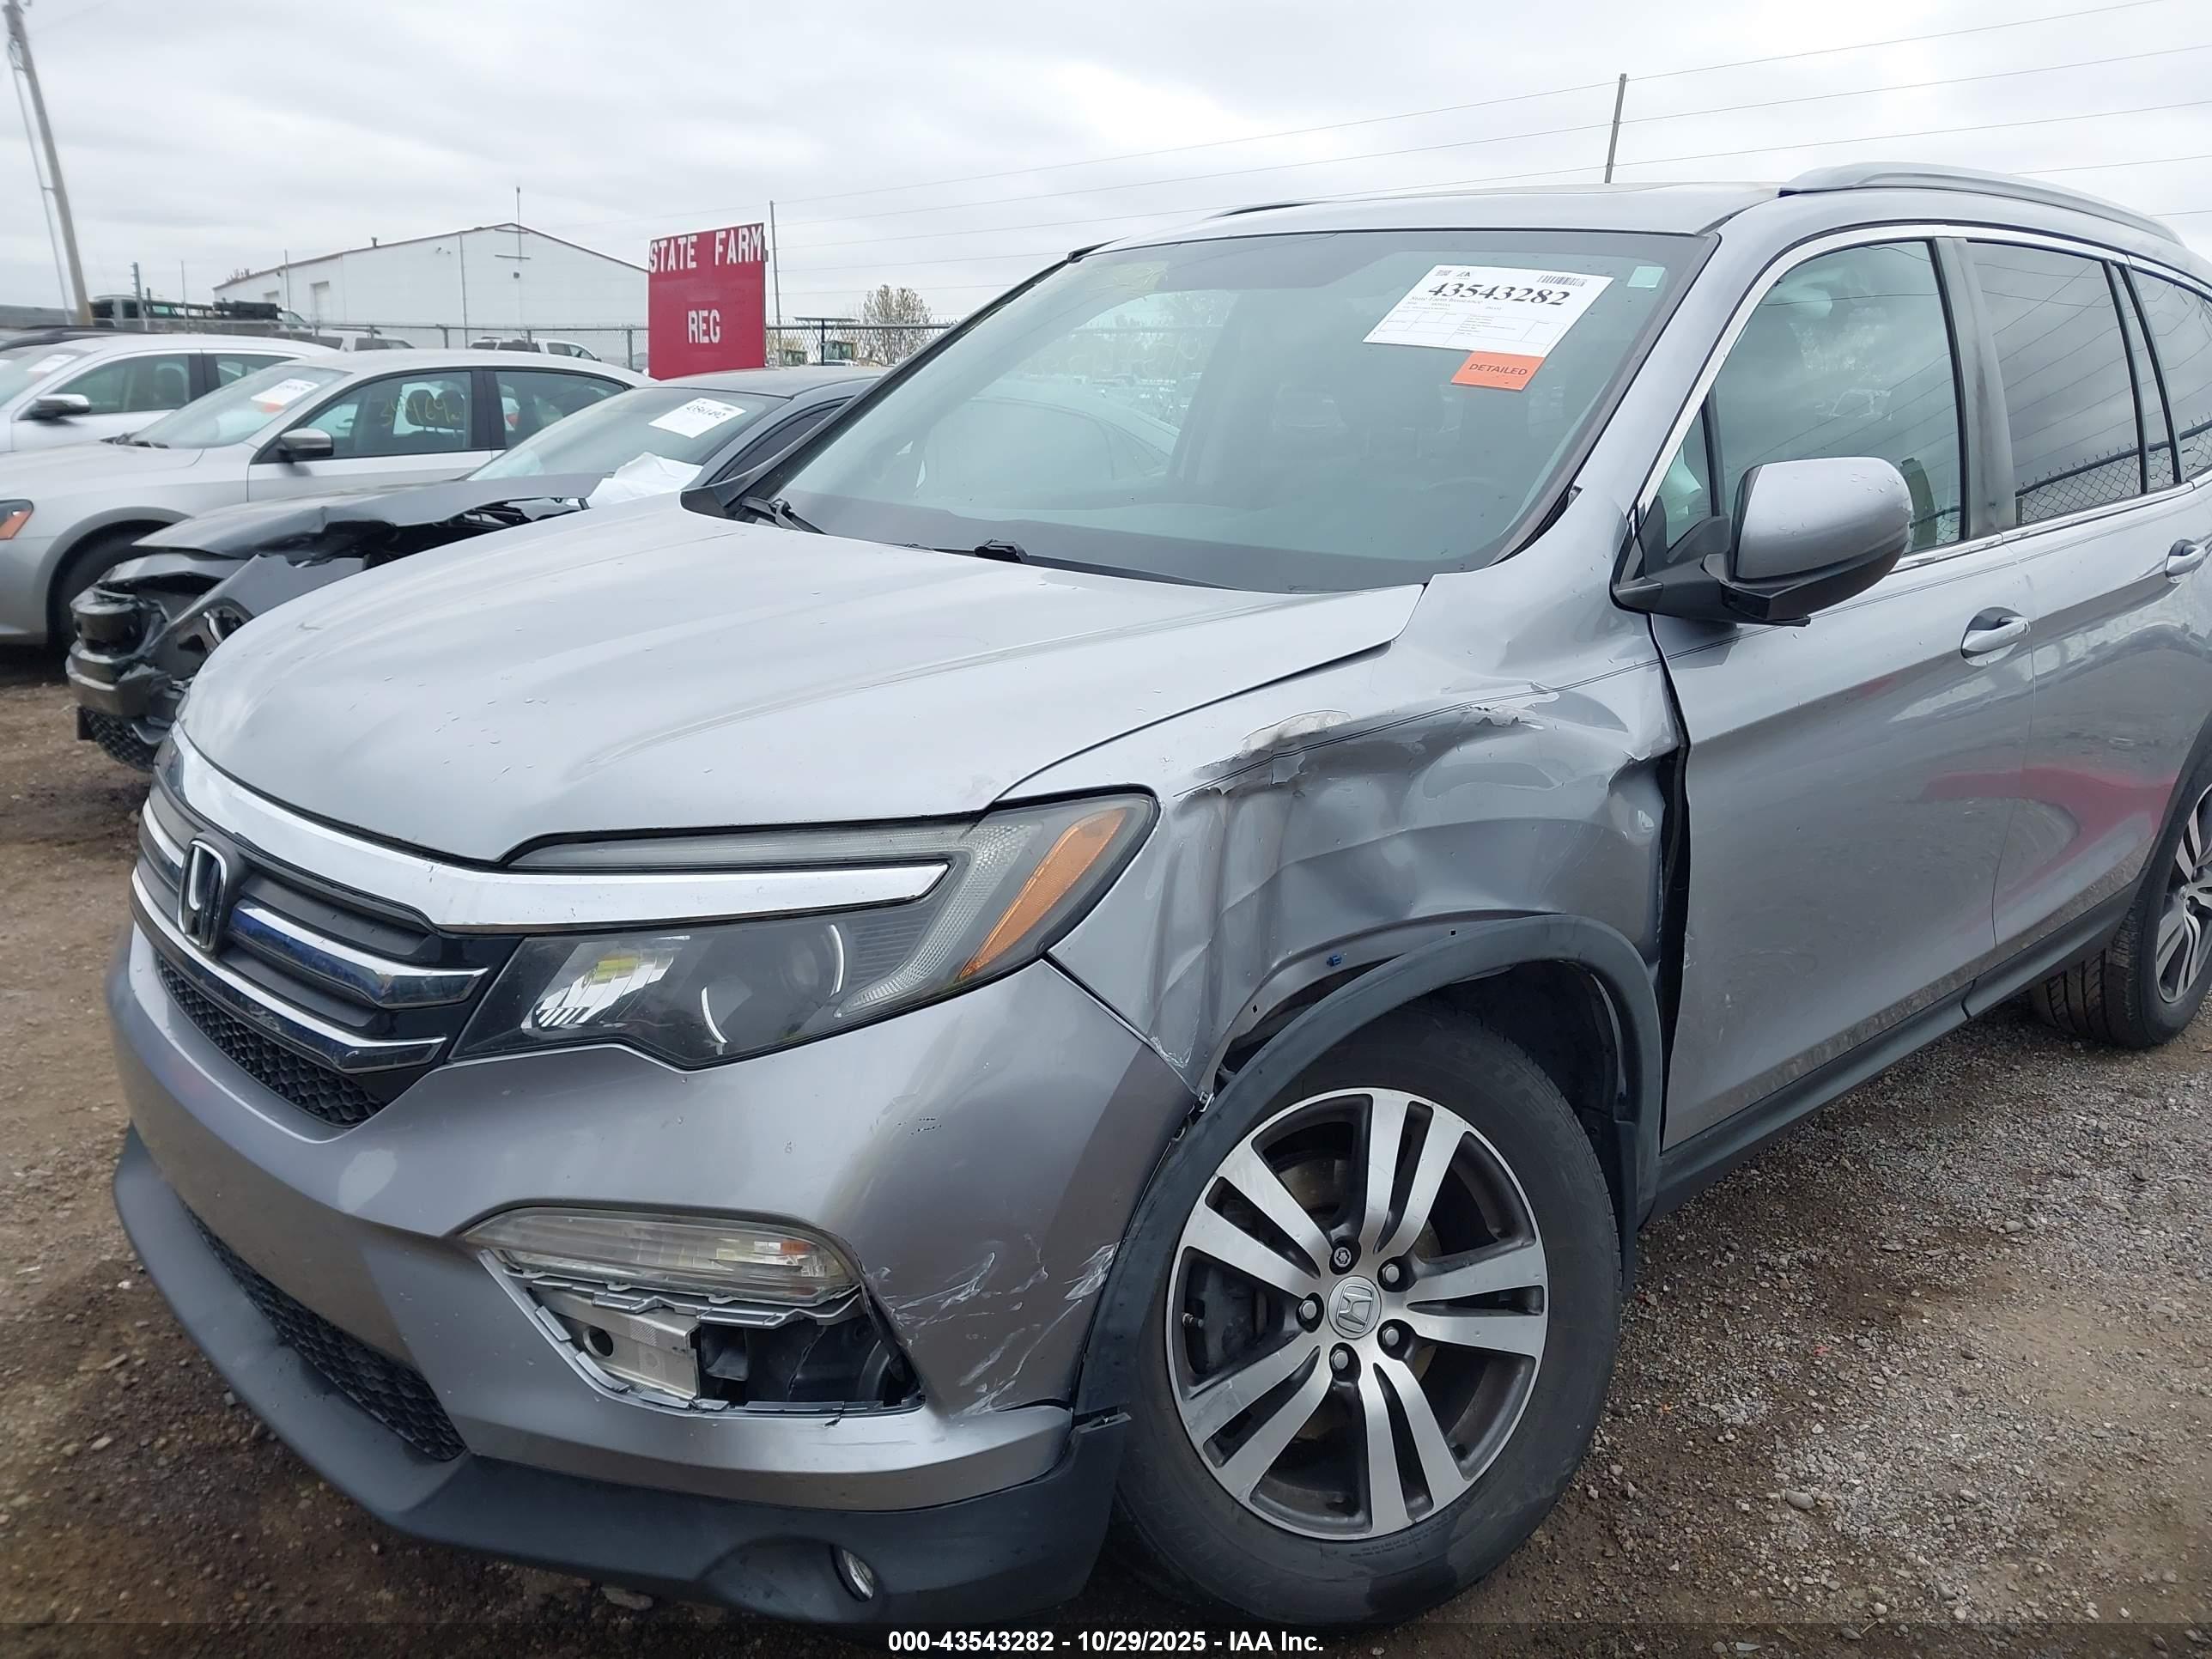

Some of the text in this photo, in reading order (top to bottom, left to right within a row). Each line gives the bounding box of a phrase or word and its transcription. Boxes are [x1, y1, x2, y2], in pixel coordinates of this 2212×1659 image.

[648, 225, 763, 273] STATE FARM
[1428, 283, 1571, 306] 43543282
[688, 309, 720, 343] REG
[1468, 363, 1528, 376] DETAILED
